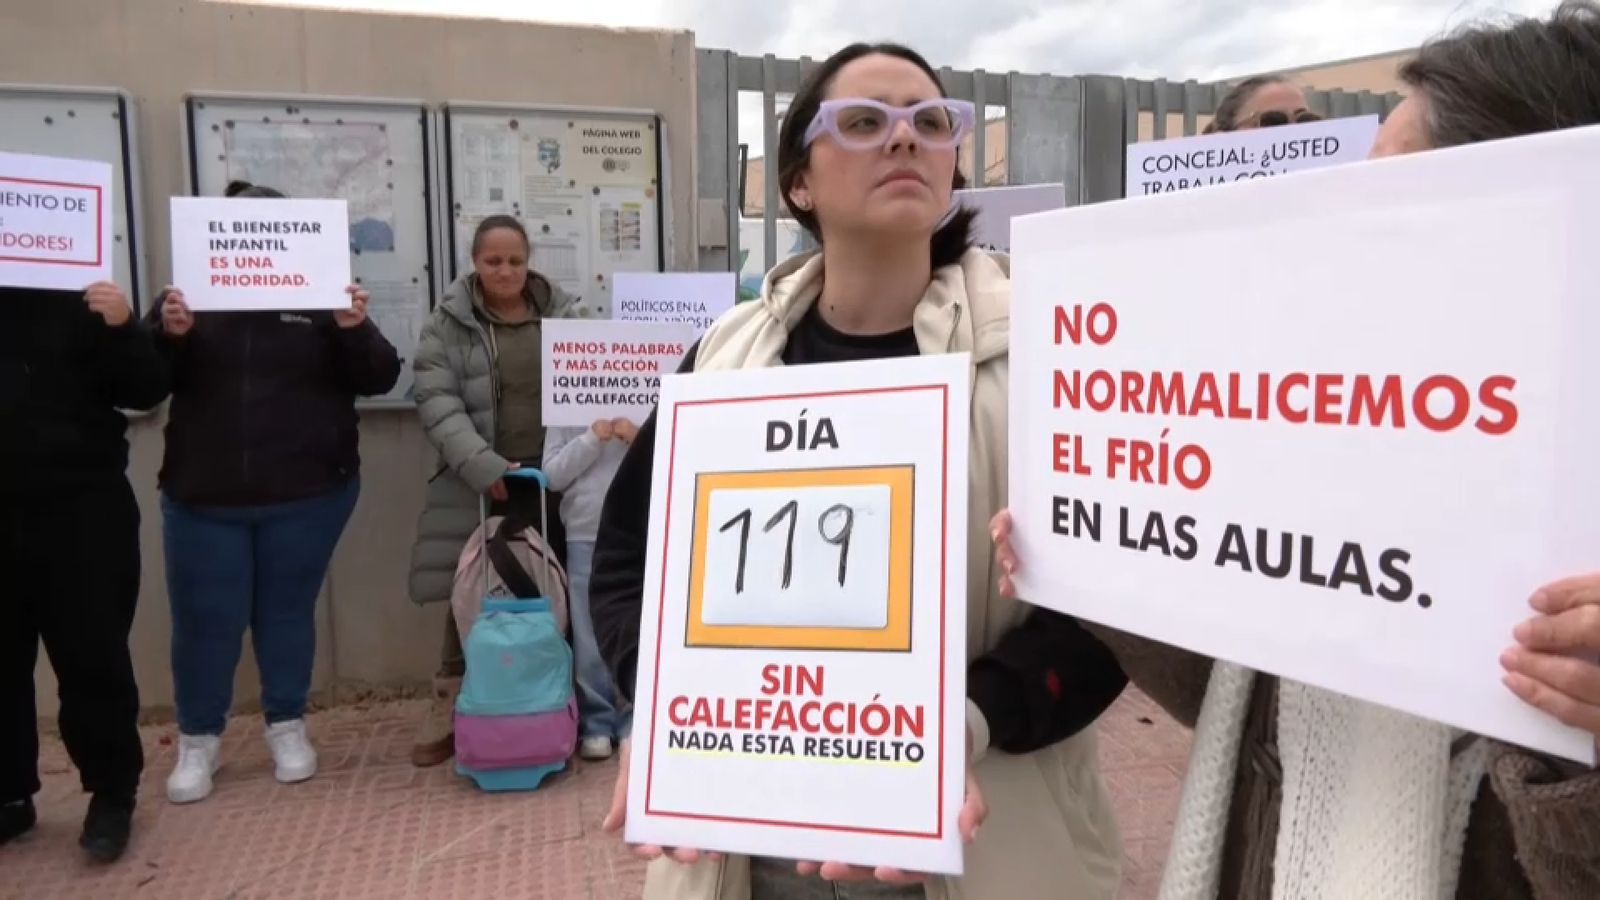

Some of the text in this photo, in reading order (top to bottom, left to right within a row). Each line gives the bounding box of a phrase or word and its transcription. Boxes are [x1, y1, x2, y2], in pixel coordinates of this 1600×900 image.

[582, 145, 642, 155] DEL COLEGIO
[1142, 136, 1340, 175] CONCEJAL: ¿USTED
[63, 195, 87, 212] DE
[208, 221, 322, 234] EL BIENESTAR
[209, 238, 289, 251] INFANTIL
[210, 256, 273, 269] ES UNA
[210, 274, 310, 287] PRIORIDAD.
[620, 299, 707, 312] POLÍTICOS EN LA
[1053, 302, 1118, 345] NO
[552, 341, 685, 356] MENOS PALABRAS
[552, 356, 660, 372] Y MÁS ACCIÓN
[552, 375, 640, 389] ¡QUEREMOS
[552, 393, 571, 405] LA
[1053, 369, 1520, 436] NORMALICEMOS
[764, 408, 841, 452] DÍA
[1051, 427, 1213, 491] EL FRÍO
[718, 500, 856, 596] 119
[1051, 495, 1434, 610] EN LAS AULAS.
[760, 663, 825, 697] SIN
[667, 693, 925, 738] CALEFACCIÓN
[667, 730, 925, 764] NADA ESTA RESUELTO
